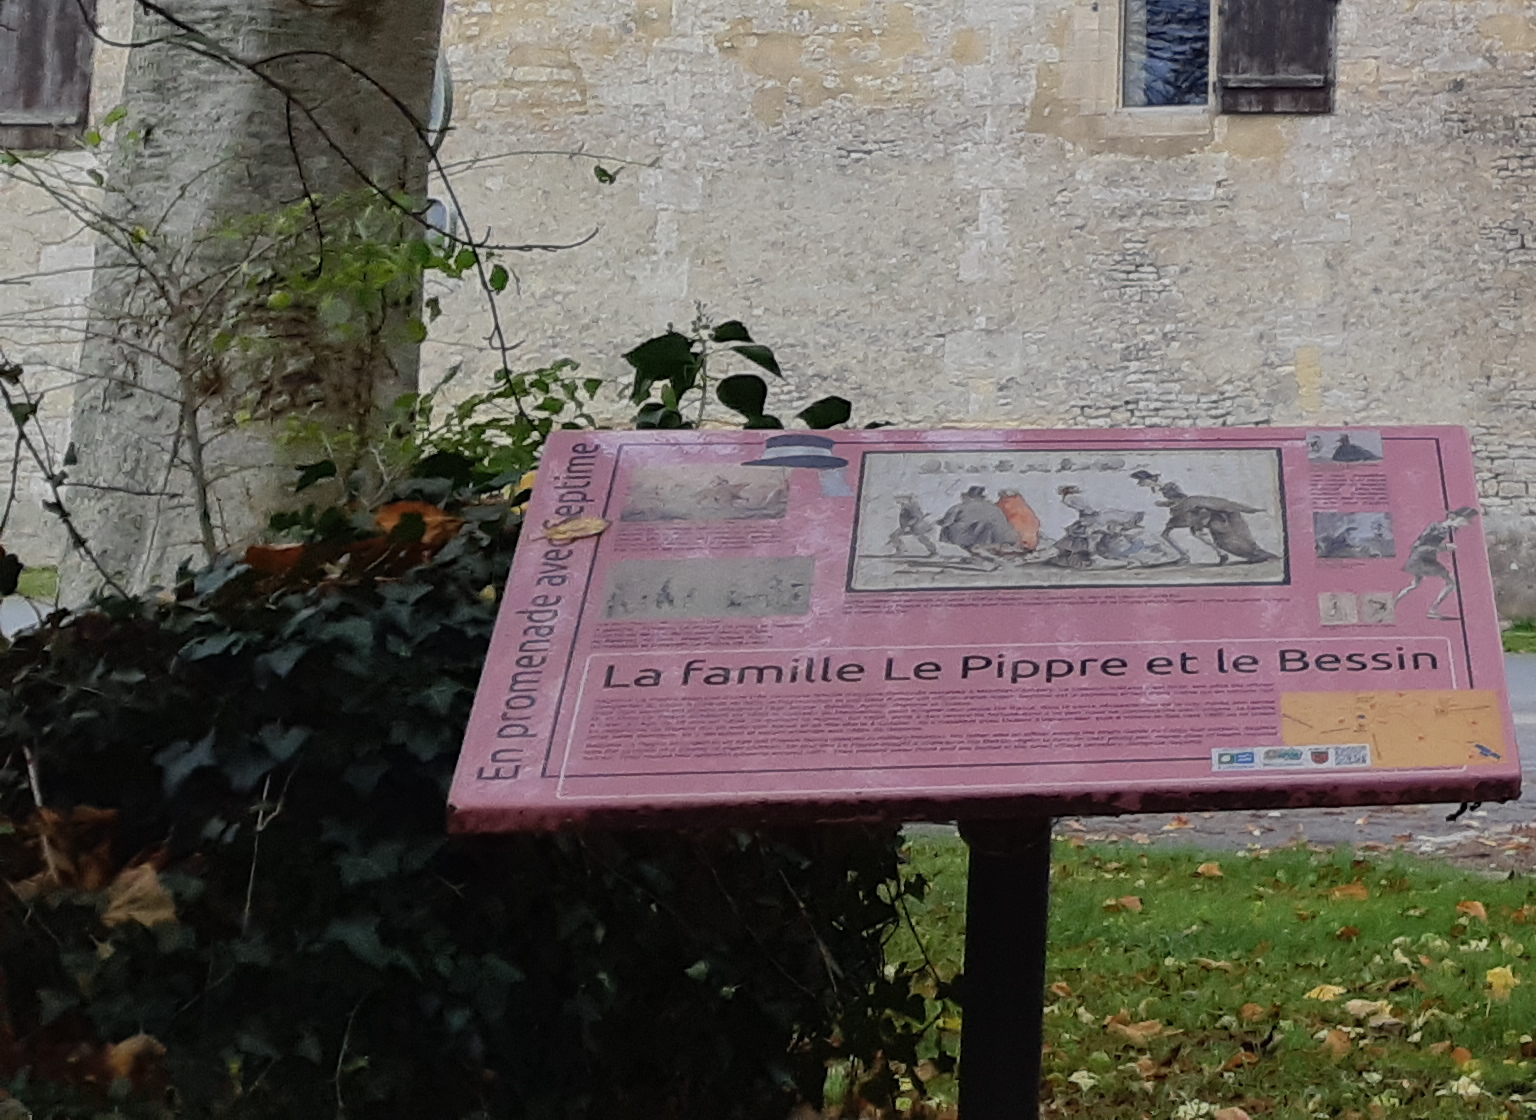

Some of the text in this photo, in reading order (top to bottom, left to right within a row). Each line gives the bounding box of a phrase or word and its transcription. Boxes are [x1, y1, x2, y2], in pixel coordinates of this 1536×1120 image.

[496, 594, 562, 739] promenade
[602, 646, 1439, 689] La famille Le Pippre et le Bessin
[476, 748, 523, 781] En
